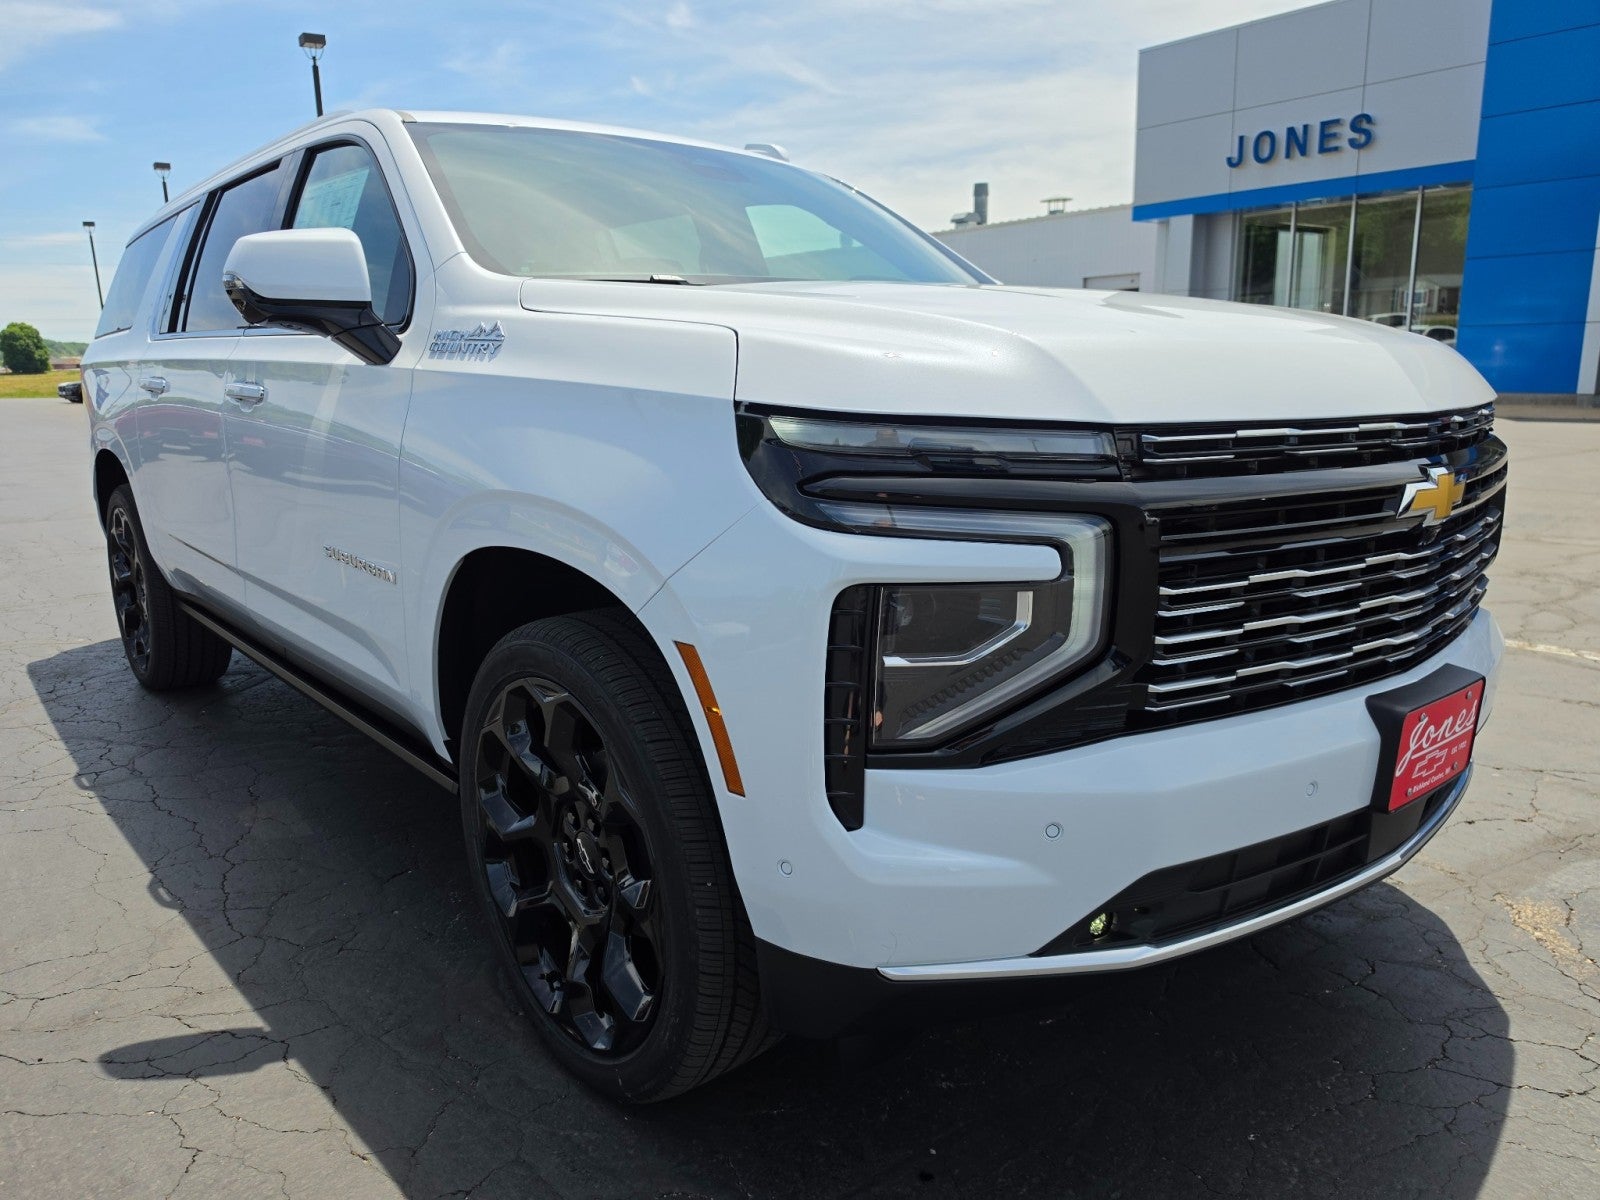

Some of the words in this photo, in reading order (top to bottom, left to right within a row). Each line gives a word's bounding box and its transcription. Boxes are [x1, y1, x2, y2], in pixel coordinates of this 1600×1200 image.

[1226, 113, 1374, 168] JONES
[429, 341, 503, 357] COUNTRY
[323, 544, 397, 585] SUBURBAN
[1395, 699, 1478, 778] Jones
